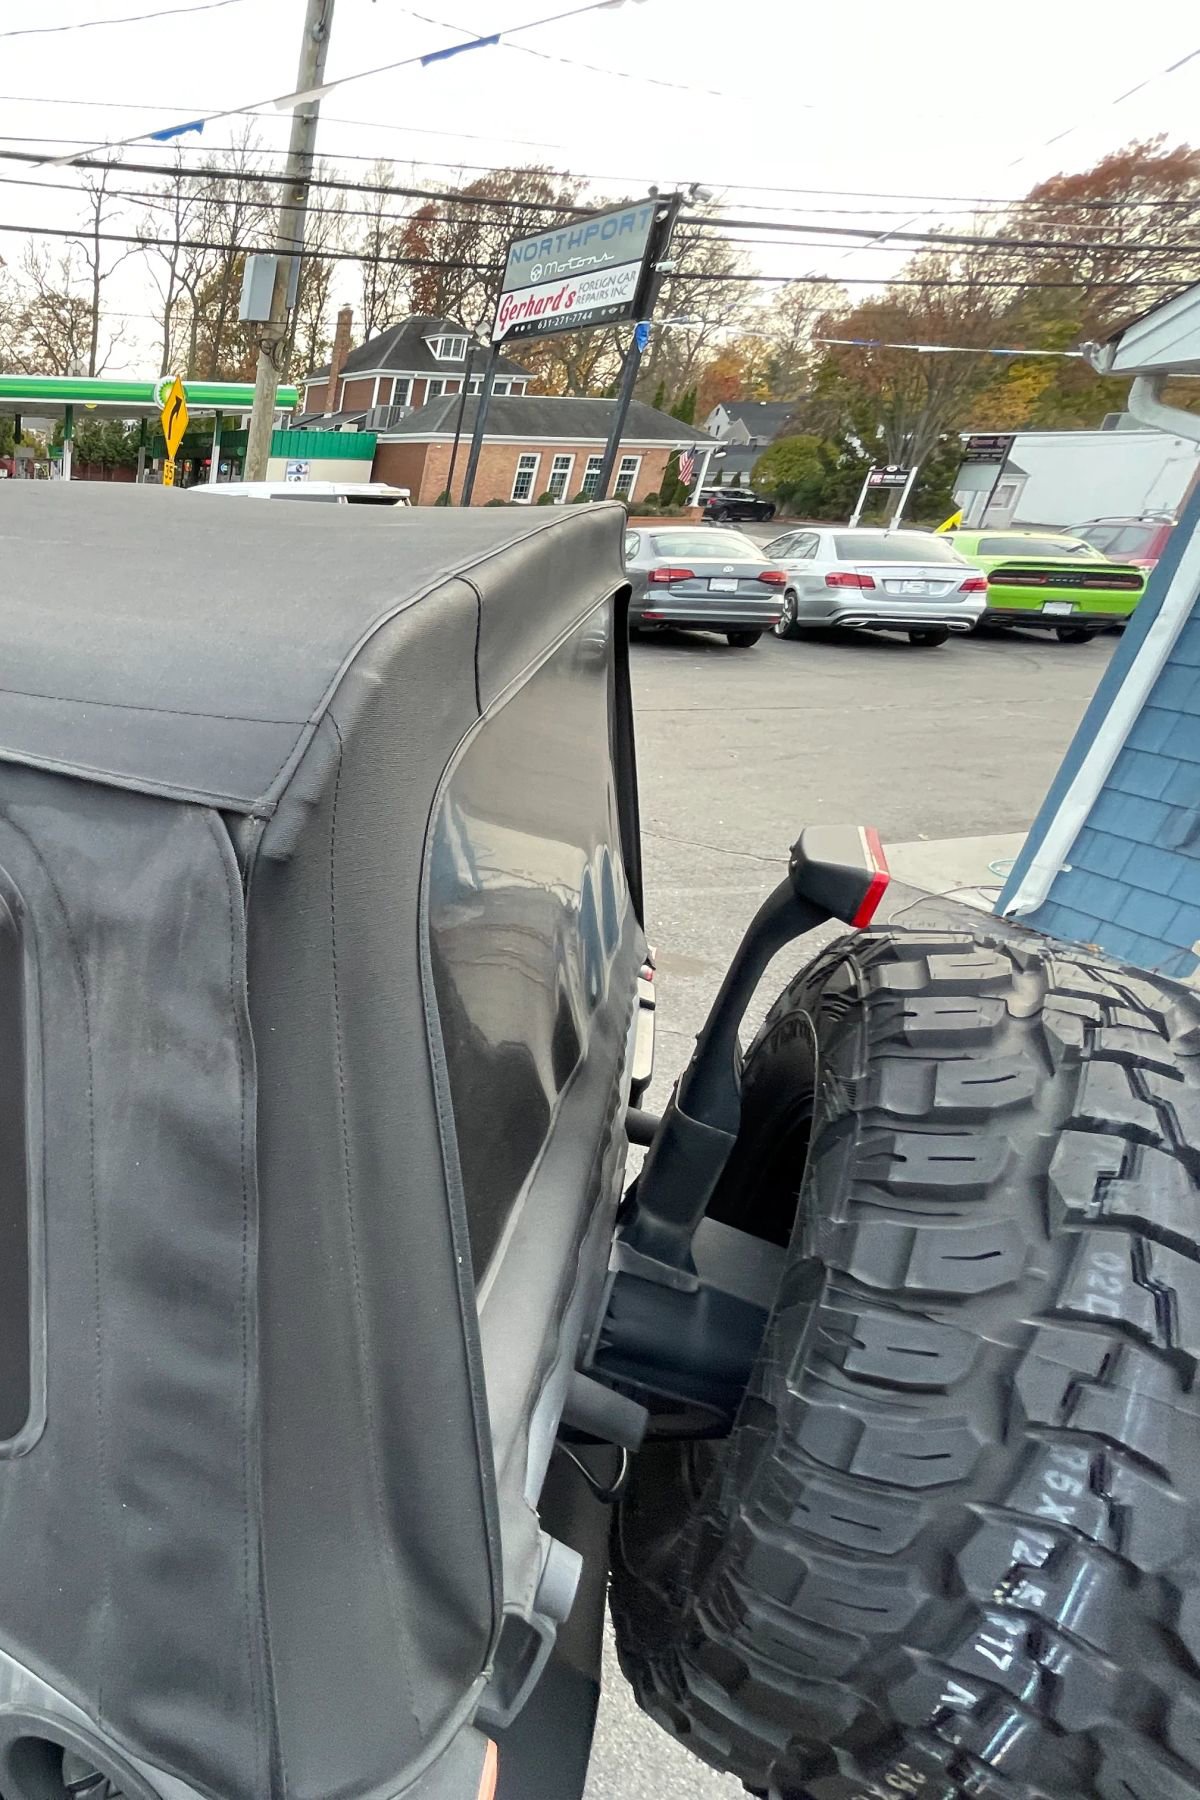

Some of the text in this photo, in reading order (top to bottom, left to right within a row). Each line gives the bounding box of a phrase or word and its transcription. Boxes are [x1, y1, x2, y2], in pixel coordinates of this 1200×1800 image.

[509, 208, 650, 266] NORTHPORT
[543, 252, 614, 277] Motors
[578, 270, 636, 293] FOREIGN CAR
[575, 285, 629, 305] REPAIRS INC
[499, 284, 576, 331] Gerhard's
[537, 311, 592, 330] 631-271-7744
